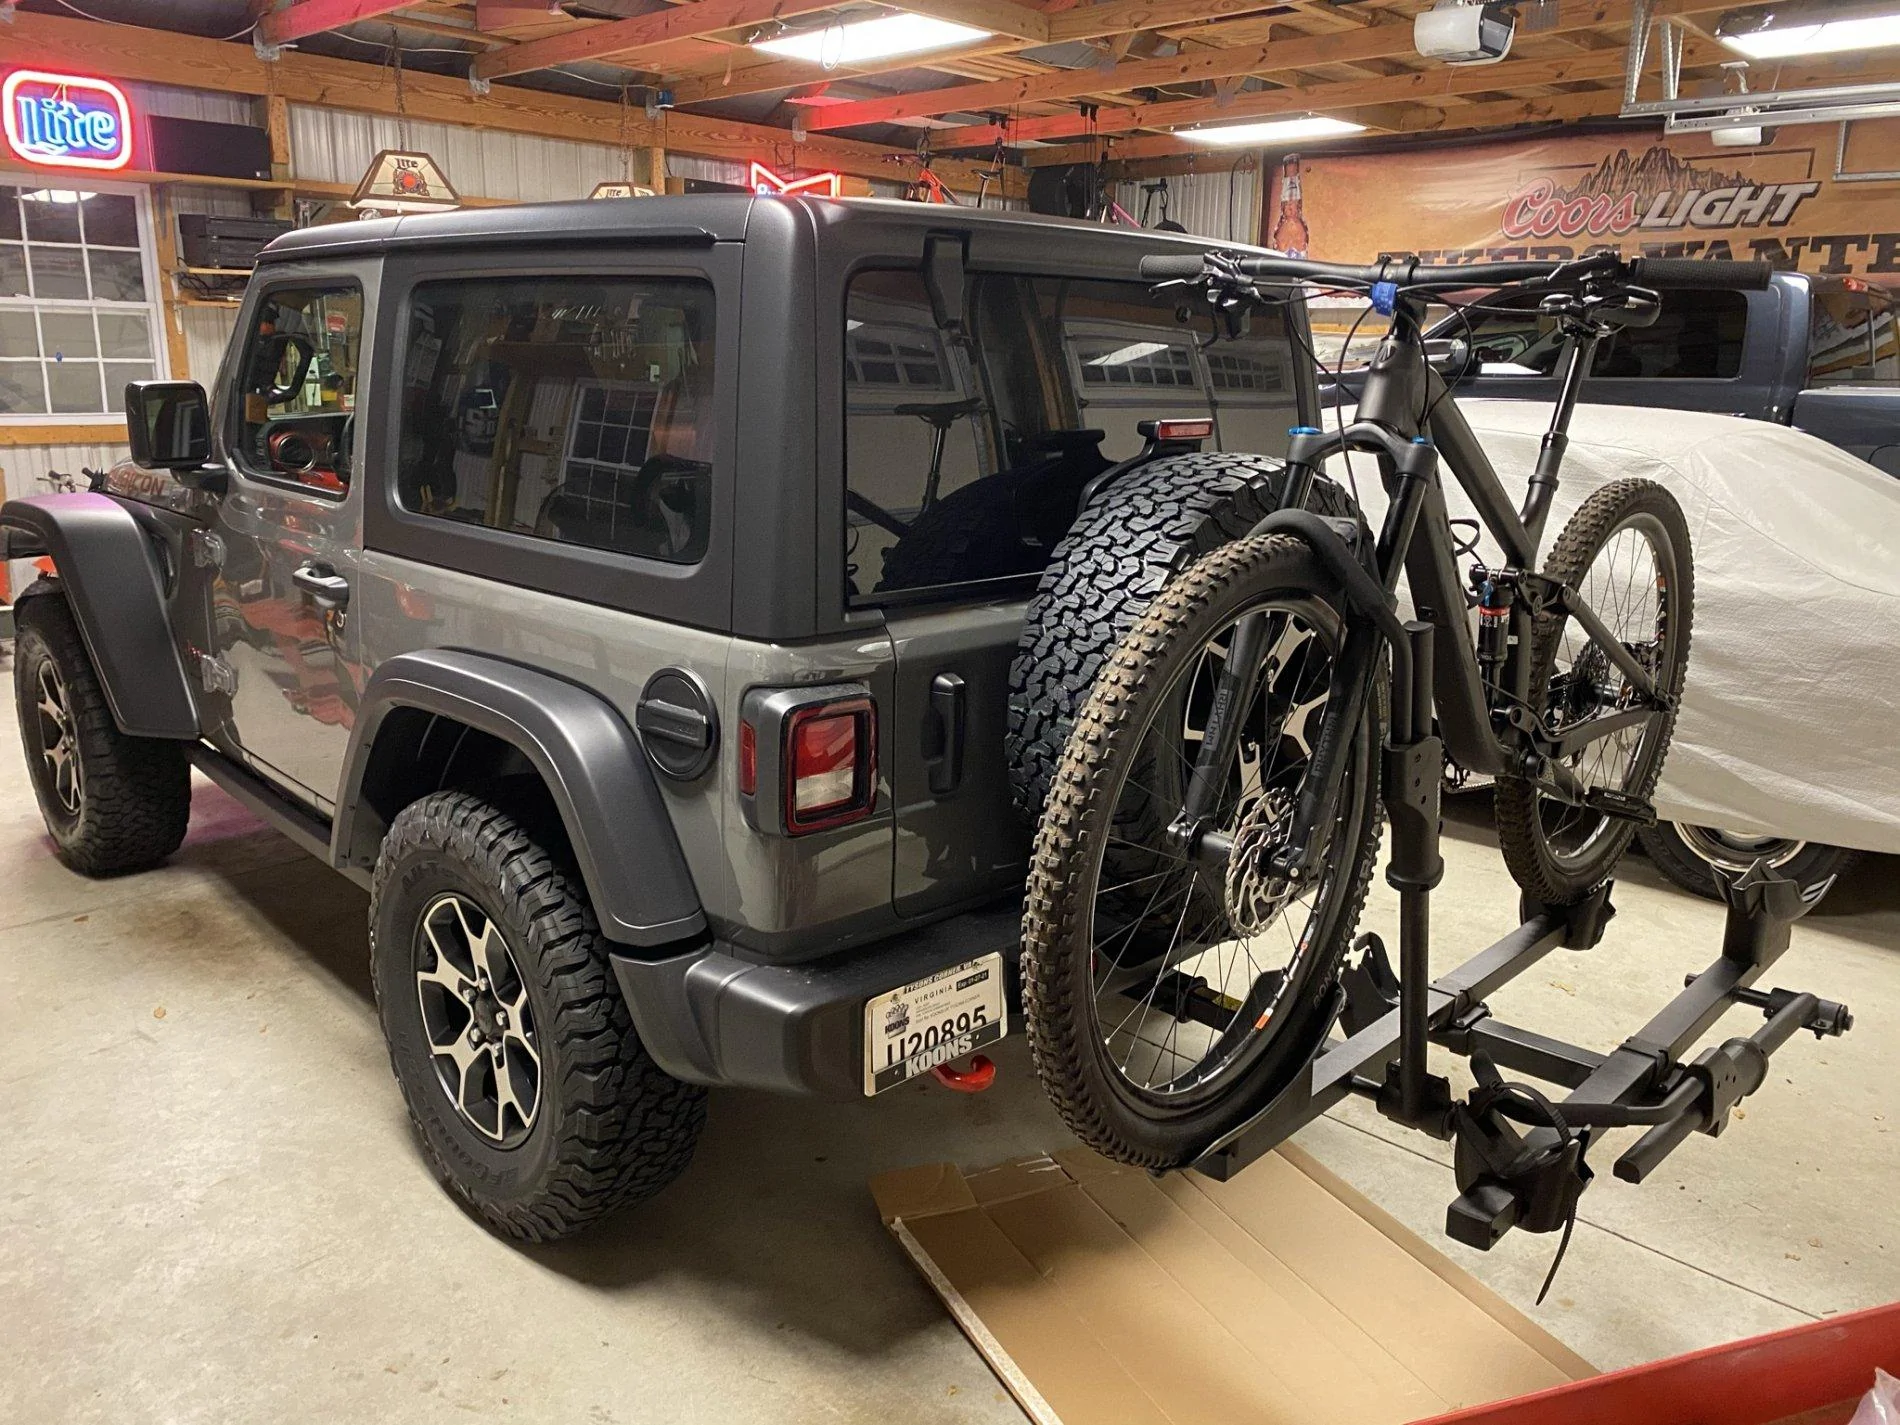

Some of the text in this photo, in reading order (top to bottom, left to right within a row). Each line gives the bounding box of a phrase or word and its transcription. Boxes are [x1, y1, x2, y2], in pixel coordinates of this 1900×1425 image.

[16, 96, 117, 155] Lite
[394, 158, 418, 170] Lite
[1501, 177, 1822, 239] Coors LIGHT
[914, 985, 953, 1004] VIRGINIA
[884, 1016, 909, 1034] KOONS
[905, 1033, 973, 1078] KOONS
